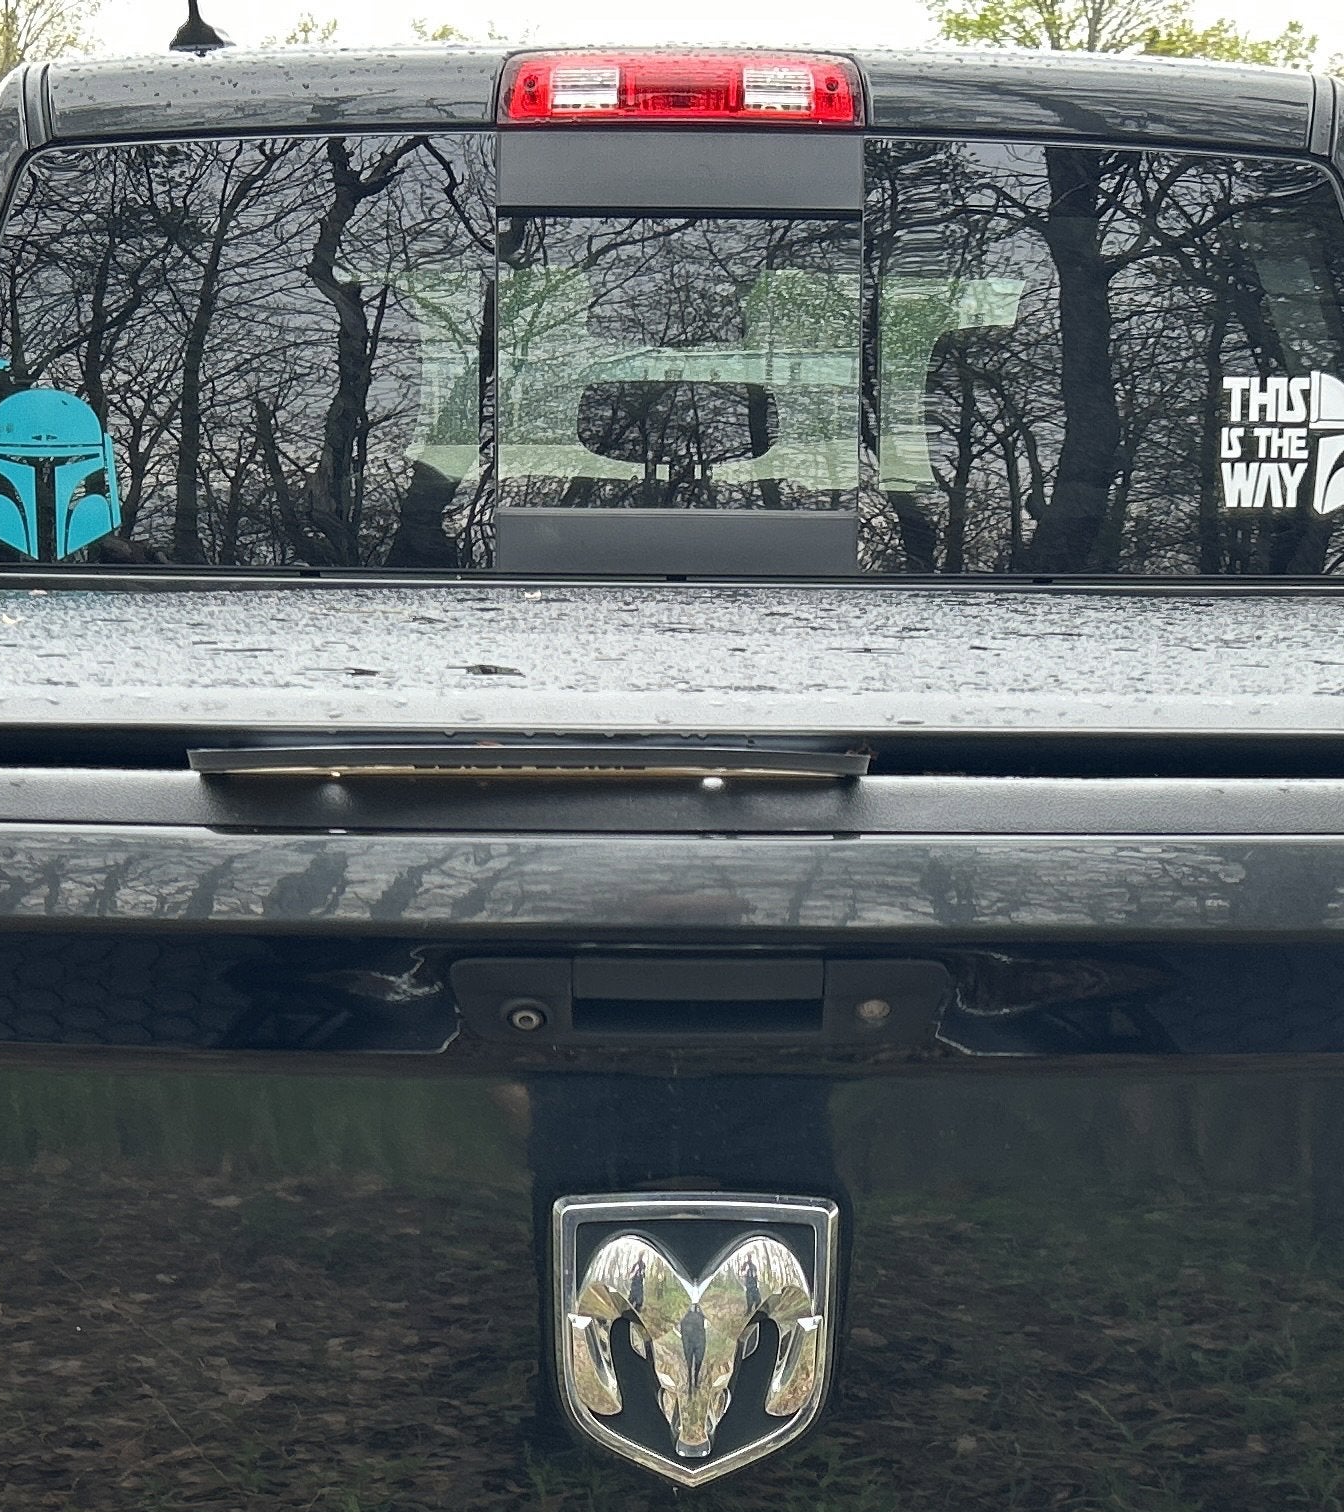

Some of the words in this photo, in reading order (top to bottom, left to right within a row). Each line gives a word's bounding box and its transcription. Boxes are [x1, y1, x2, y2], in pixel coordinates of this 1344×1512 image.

[1222, 376, 1311, 423] THIS
[1220, 427, 1245, 459] IS
[1253, 427, 1309, 459] THE
[1220, 462, 1309, 508] WAY
